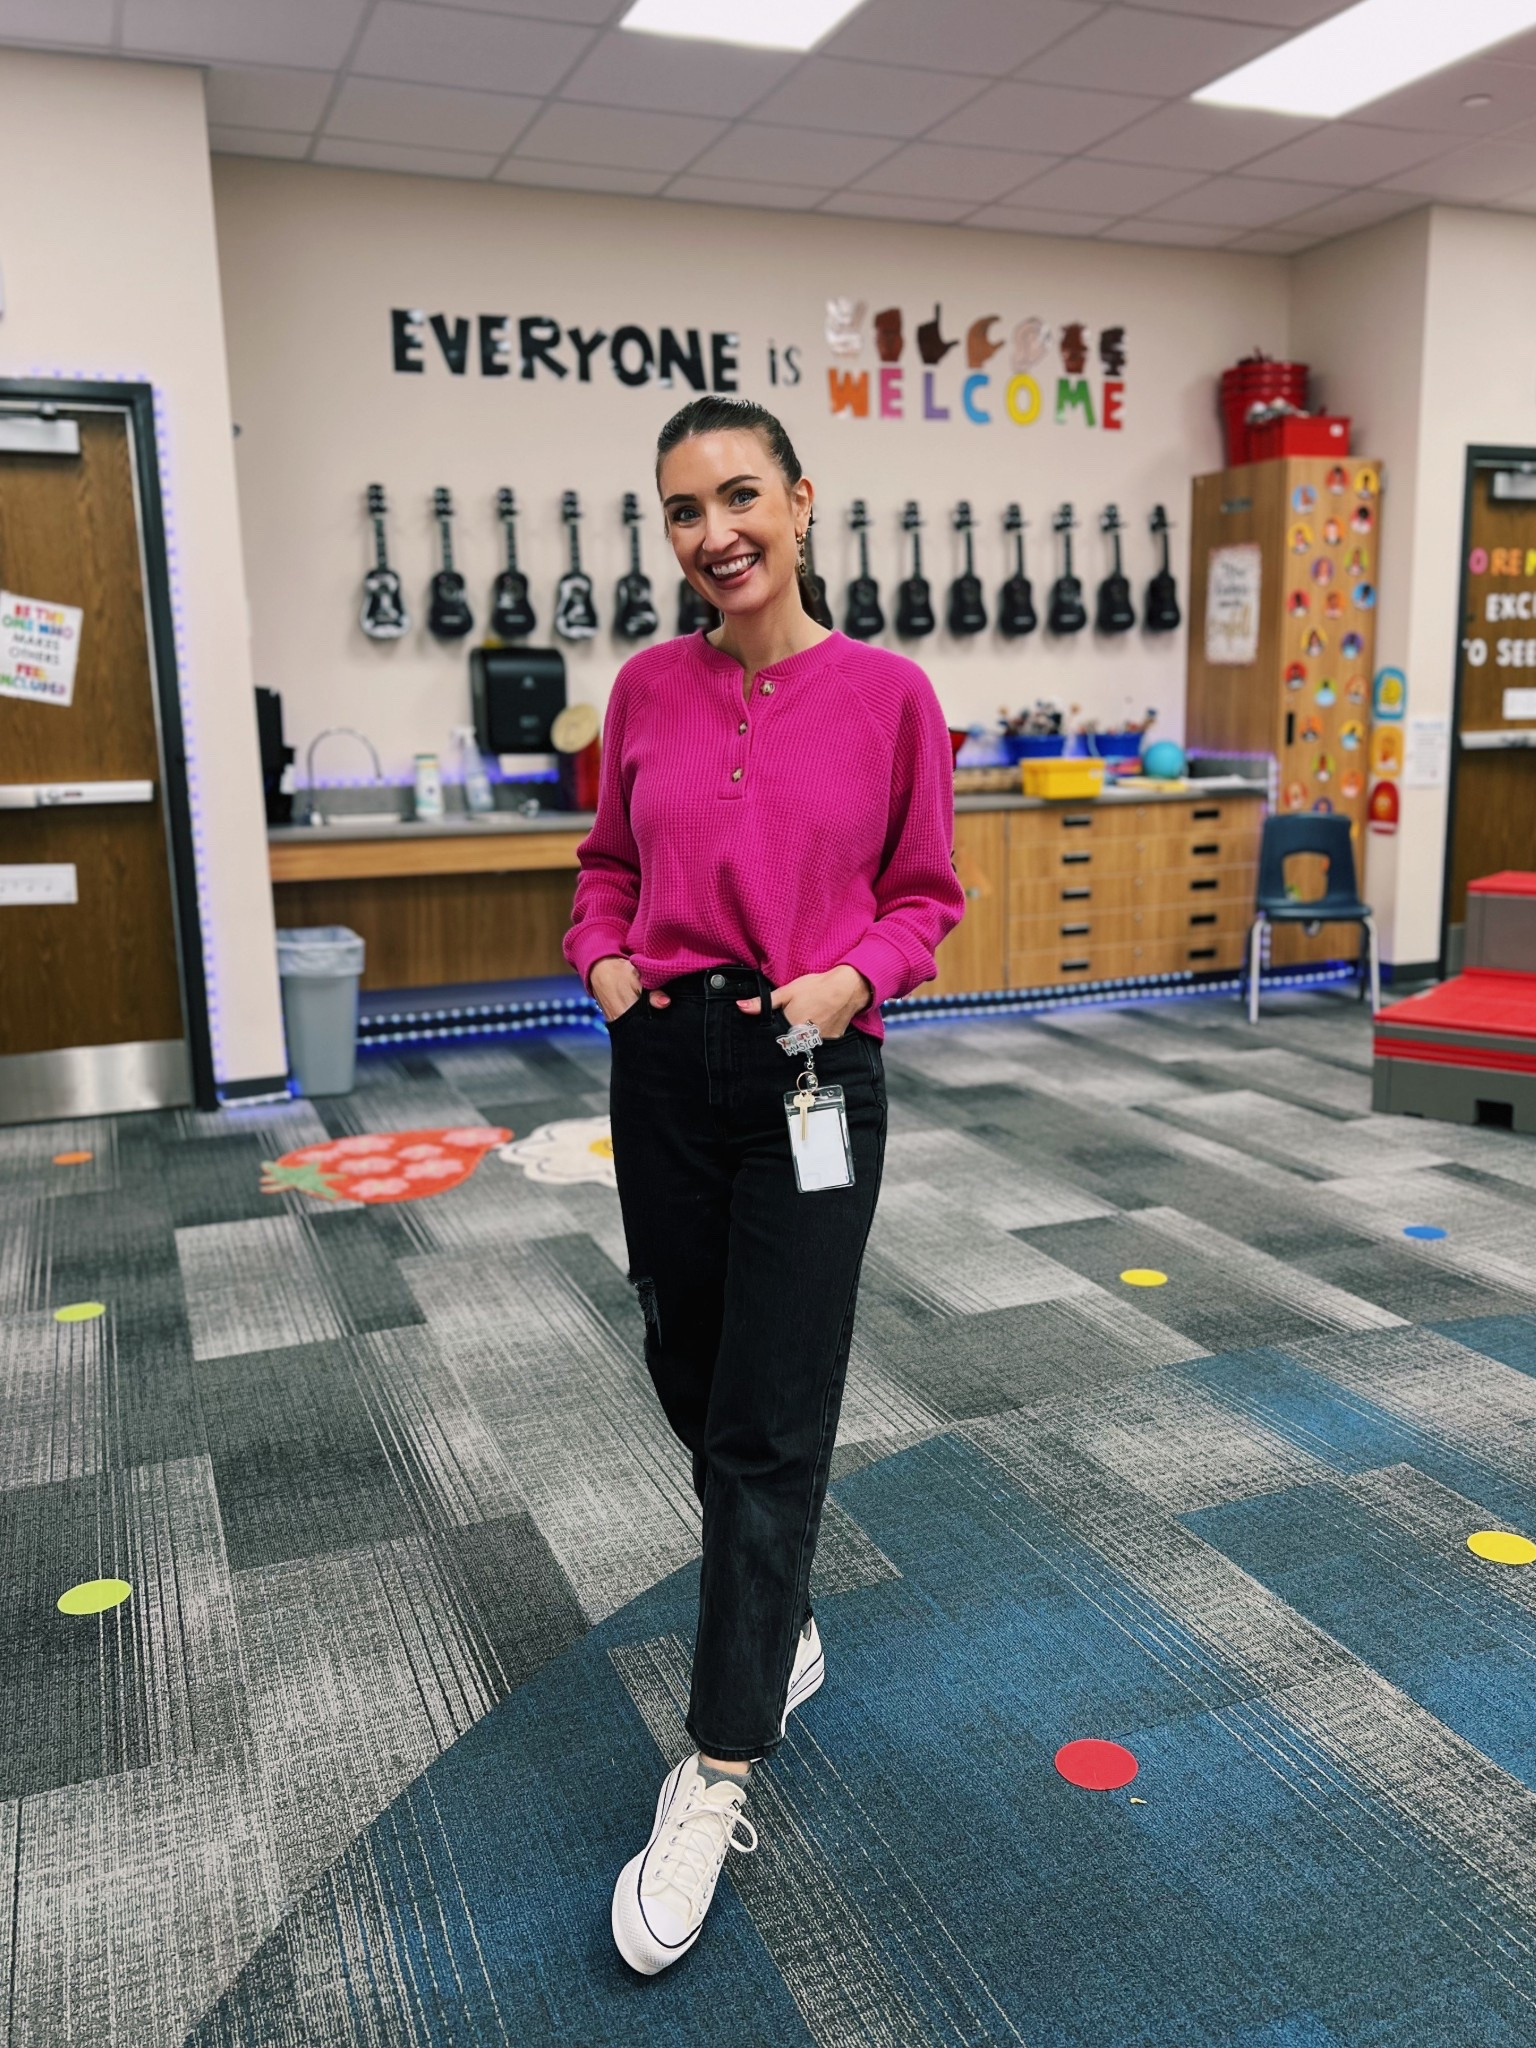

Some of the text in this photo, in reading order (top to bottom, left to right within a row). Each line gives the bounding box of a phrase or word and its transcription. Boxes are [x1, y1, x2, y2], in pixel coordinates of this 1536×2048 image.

[391, 309, 739, 392] EVERYONE
[827, 367, 1125, 430] WELCOME
[2, 614, 73, 640] ONE WHO
[13, 633, 60, 652] MAKES
[8, 646, 61, 666] OTHERS
